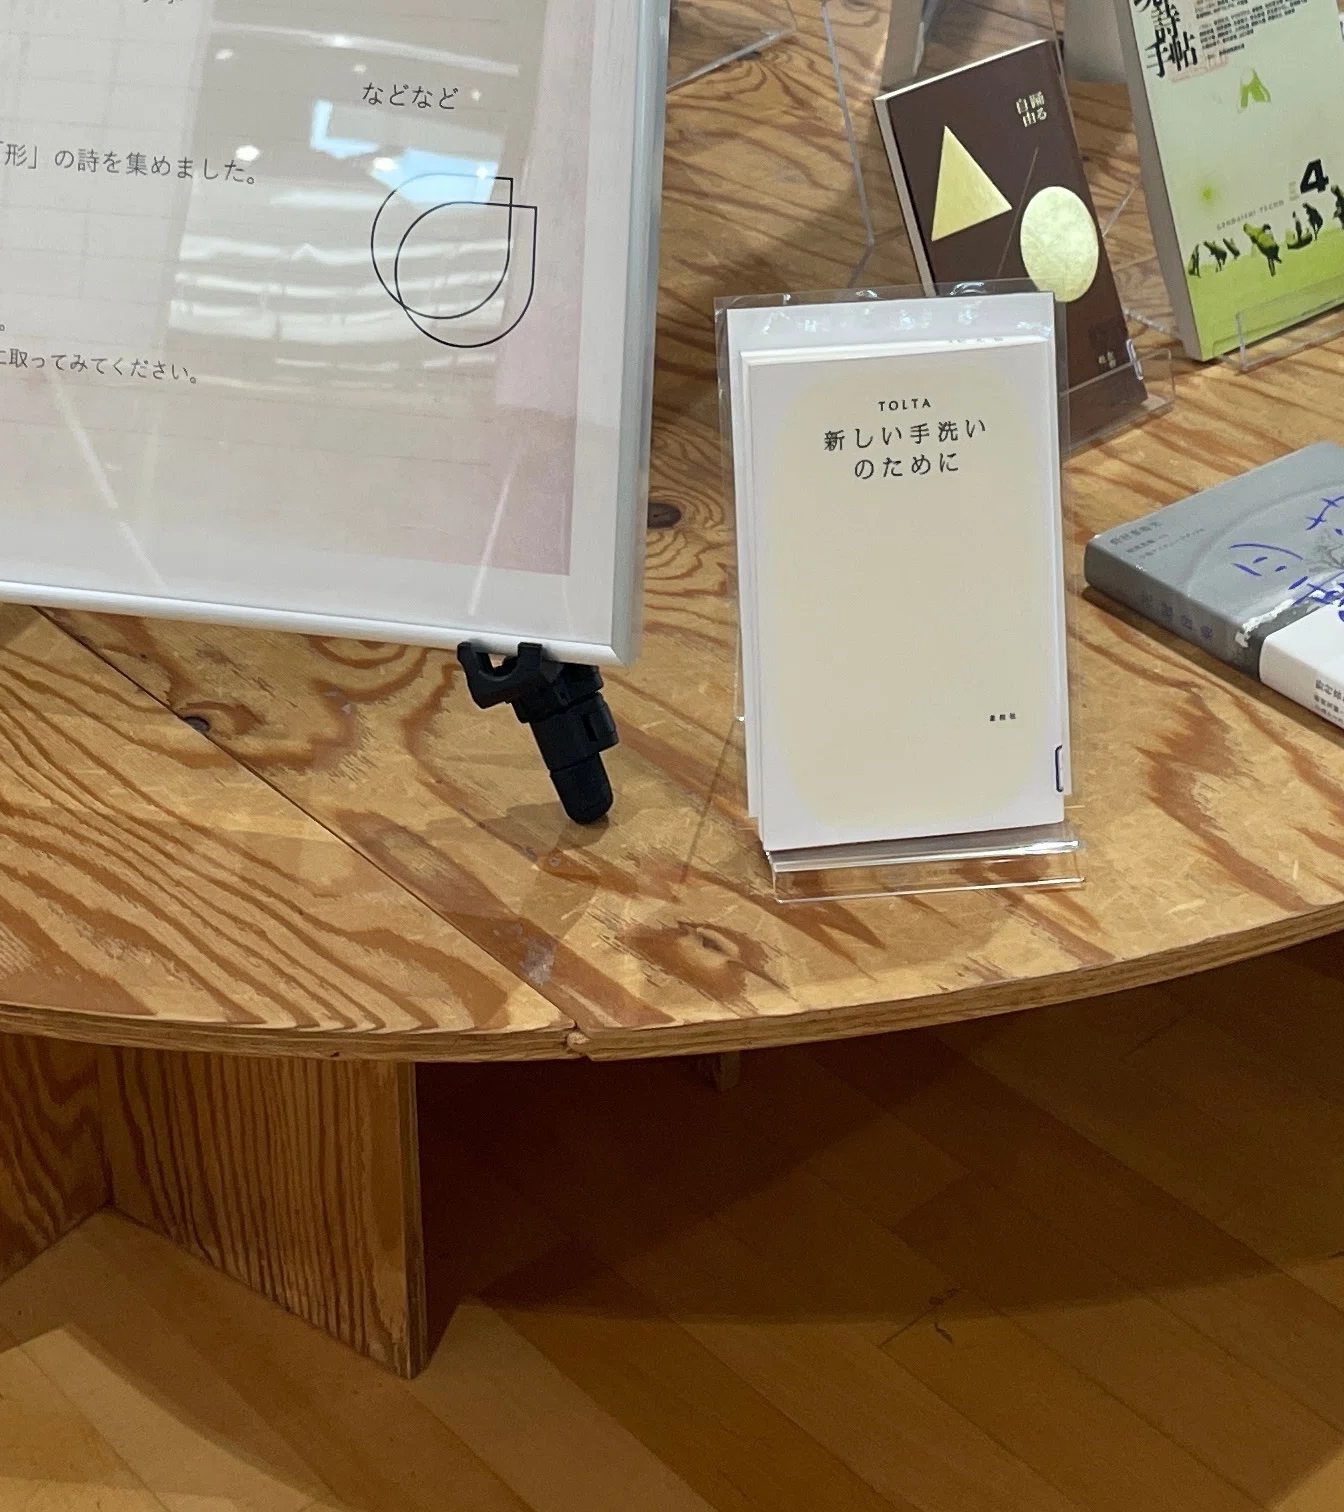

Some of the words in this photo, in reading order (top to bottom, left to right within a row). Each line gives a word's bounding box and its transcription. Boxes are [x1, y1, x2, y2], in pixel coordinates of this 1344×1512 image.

[362, 83, 458, 109] などなど
[1300, 158, 1329, 194] 4
[878, 398, 932, 412] TOLTA
[824, 418, 988, 451] 新しい手洗い
[853, 451, 960, 480] のために
